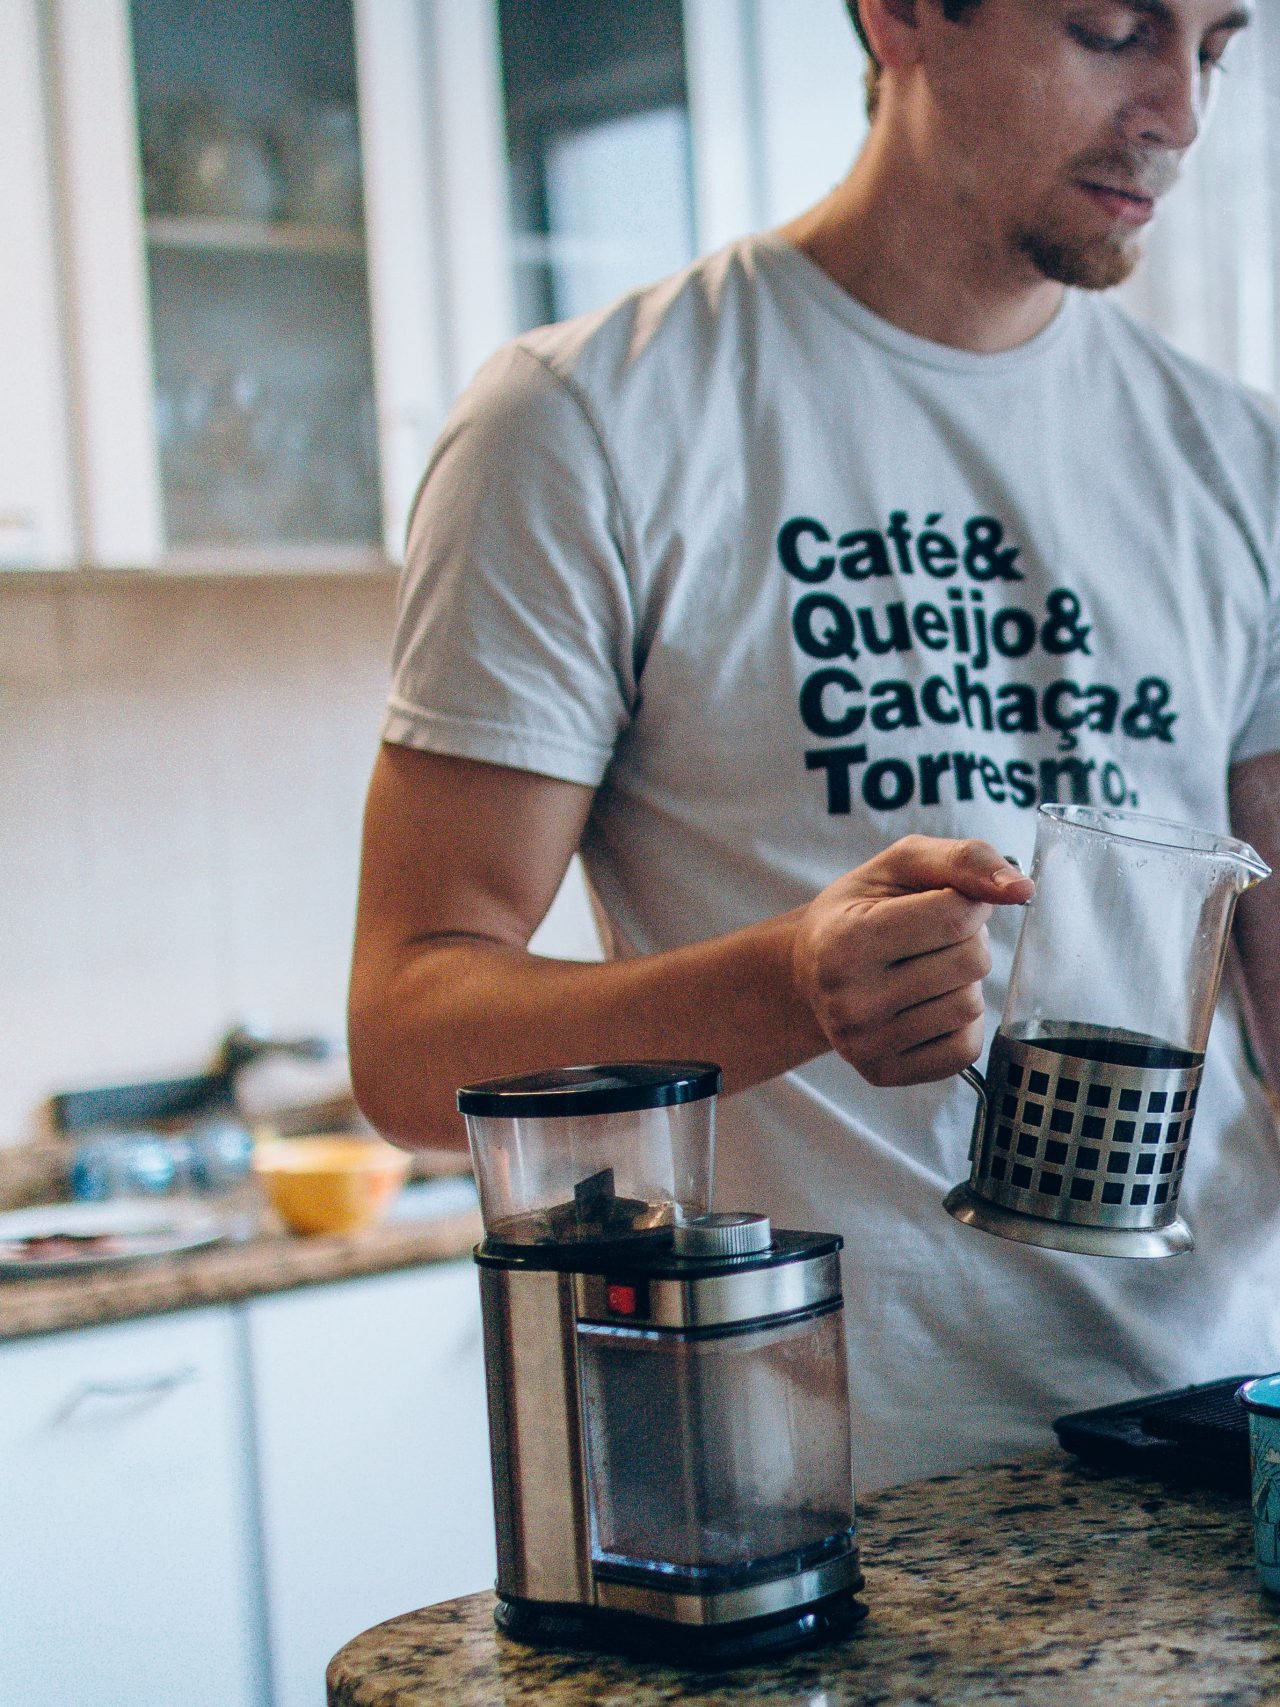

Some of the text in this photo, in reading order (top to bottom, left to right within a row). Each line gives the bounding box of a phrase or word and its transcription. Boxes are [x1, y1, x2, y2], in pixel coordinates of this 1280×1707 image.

[778, 510, 1024, 583] Café&
[792, 587, 1092, 670] Queijo&
[799, 663, 1179, 751] Cachaça&
